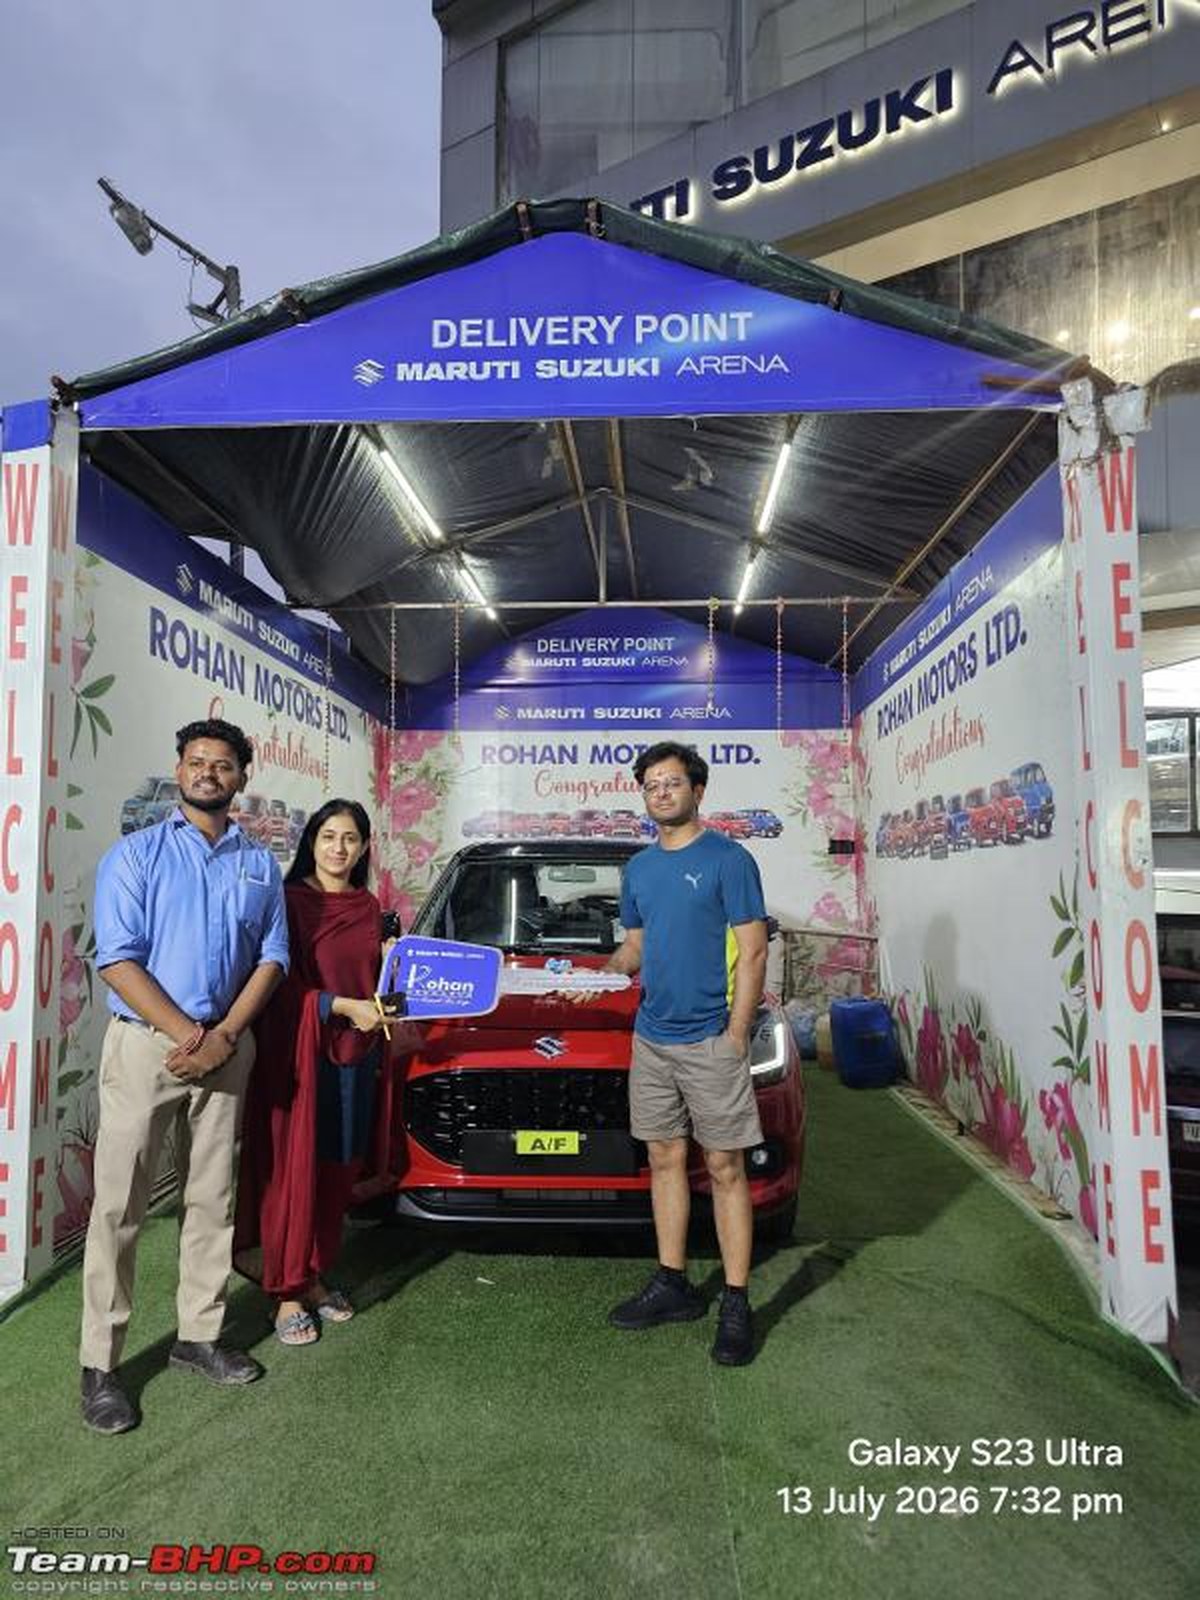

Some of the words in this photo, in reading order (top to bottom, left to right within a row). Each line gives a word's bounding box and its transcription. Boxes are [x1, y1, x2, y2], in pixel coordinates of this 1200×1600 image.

[712, 69, 954, 202] SUZUKI
[986, 0, 1166, 95] ARE
[431, 315, 622, 348] DELIVERY
[635, 311, 753, 344] POINT
[396, 360, 521, 382] MARUTI
[535, 357, 660, 379] SUZUKI
[675, 354, 790, 377] ARENA
[200, 579, 254, 632] MARUTI
[258, 619, 300, 662] SUZUKI
[537, 638, 620, 653] DELIVERY
[624, 637, 676, 651] POINT
[582, 656, 636, 667] SUZUKI
[641, 656, 690, 667] ARENA
[149, 605, 246, 695] ROHAN
[254, 663, 322, 731] MOTORS
[326, 701, 351, 744] LTD.
[877, 683, 914, 741] ROHAN
[917, 631, 979, 715] MOTORS
[985, 602, 1028, 667] LTD.
[517, 707, 585, 720] MARUTI
[594, 707, 662, 720] SUZUKI
[669, 706, 733, 719] ARENA
[481, 743, 578, 765] ROHAN
[711, 743, 762, 765] LTD.
[32, 464, 73, 1248] WELCOME
[1097, 446, 1165, 1263] WELCOME
[407, 963, 474, 992] Rohan
[530, 1136, 568, 1152] A/F
